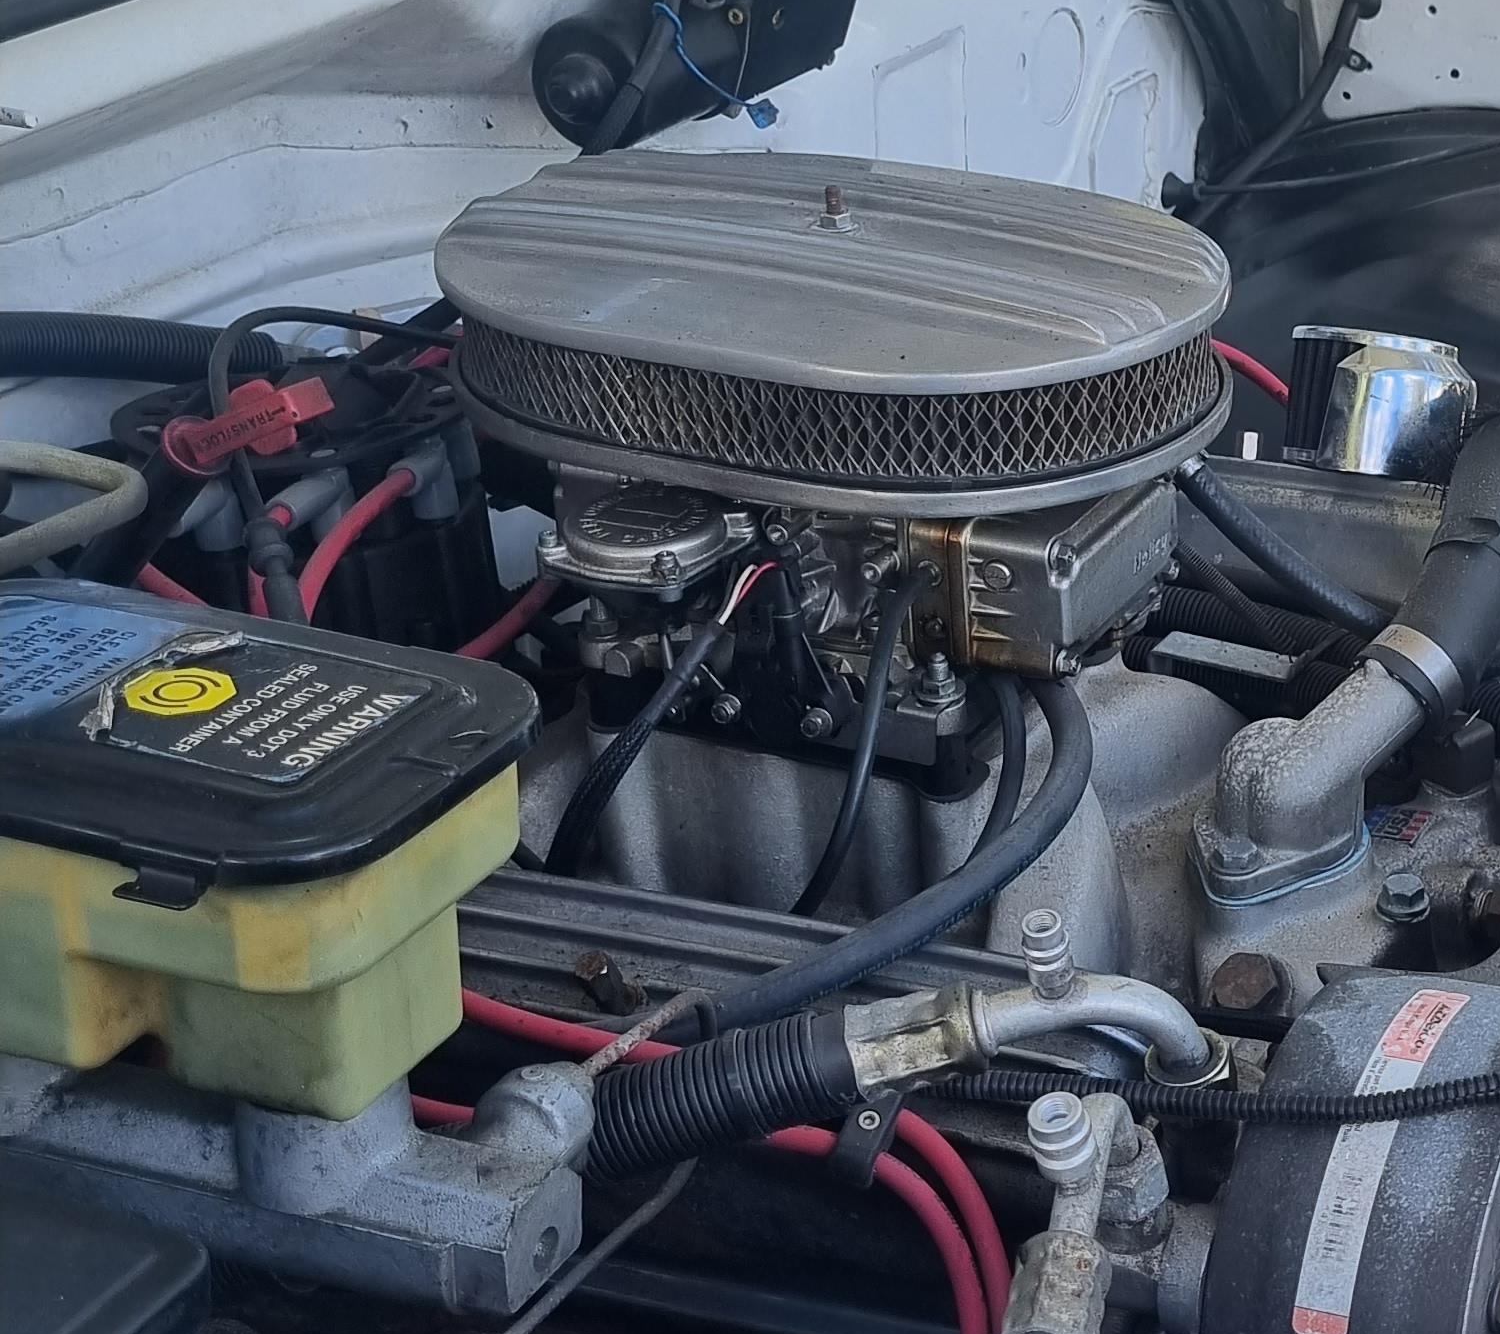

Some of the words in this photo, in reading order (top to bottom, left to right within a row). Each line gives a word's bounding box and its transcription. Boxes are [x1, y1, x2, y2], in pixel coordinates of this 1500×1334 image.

[48, 627, 88, 644] USE
[52, 628, 118, 661] BEFORE
[84, 631, 137, 658] CLEAN
[22, 661, 83, 692] FILLER
[52, 657, 128, 696] WARNING
[253, 662, 319, 699] SEALED
[278, 681, 331, 709] FLUID
[328, 685, 369, 704] USE
[167, 697, 264, 752] CONTAINER
[234, 708, 290, 737] FROM
[290, 703, 340, 730] ONLY
[220, 734, 243, 743] A
[259, 729, 300, 751] DOT
[278, 694, 409, 768] WARNING
